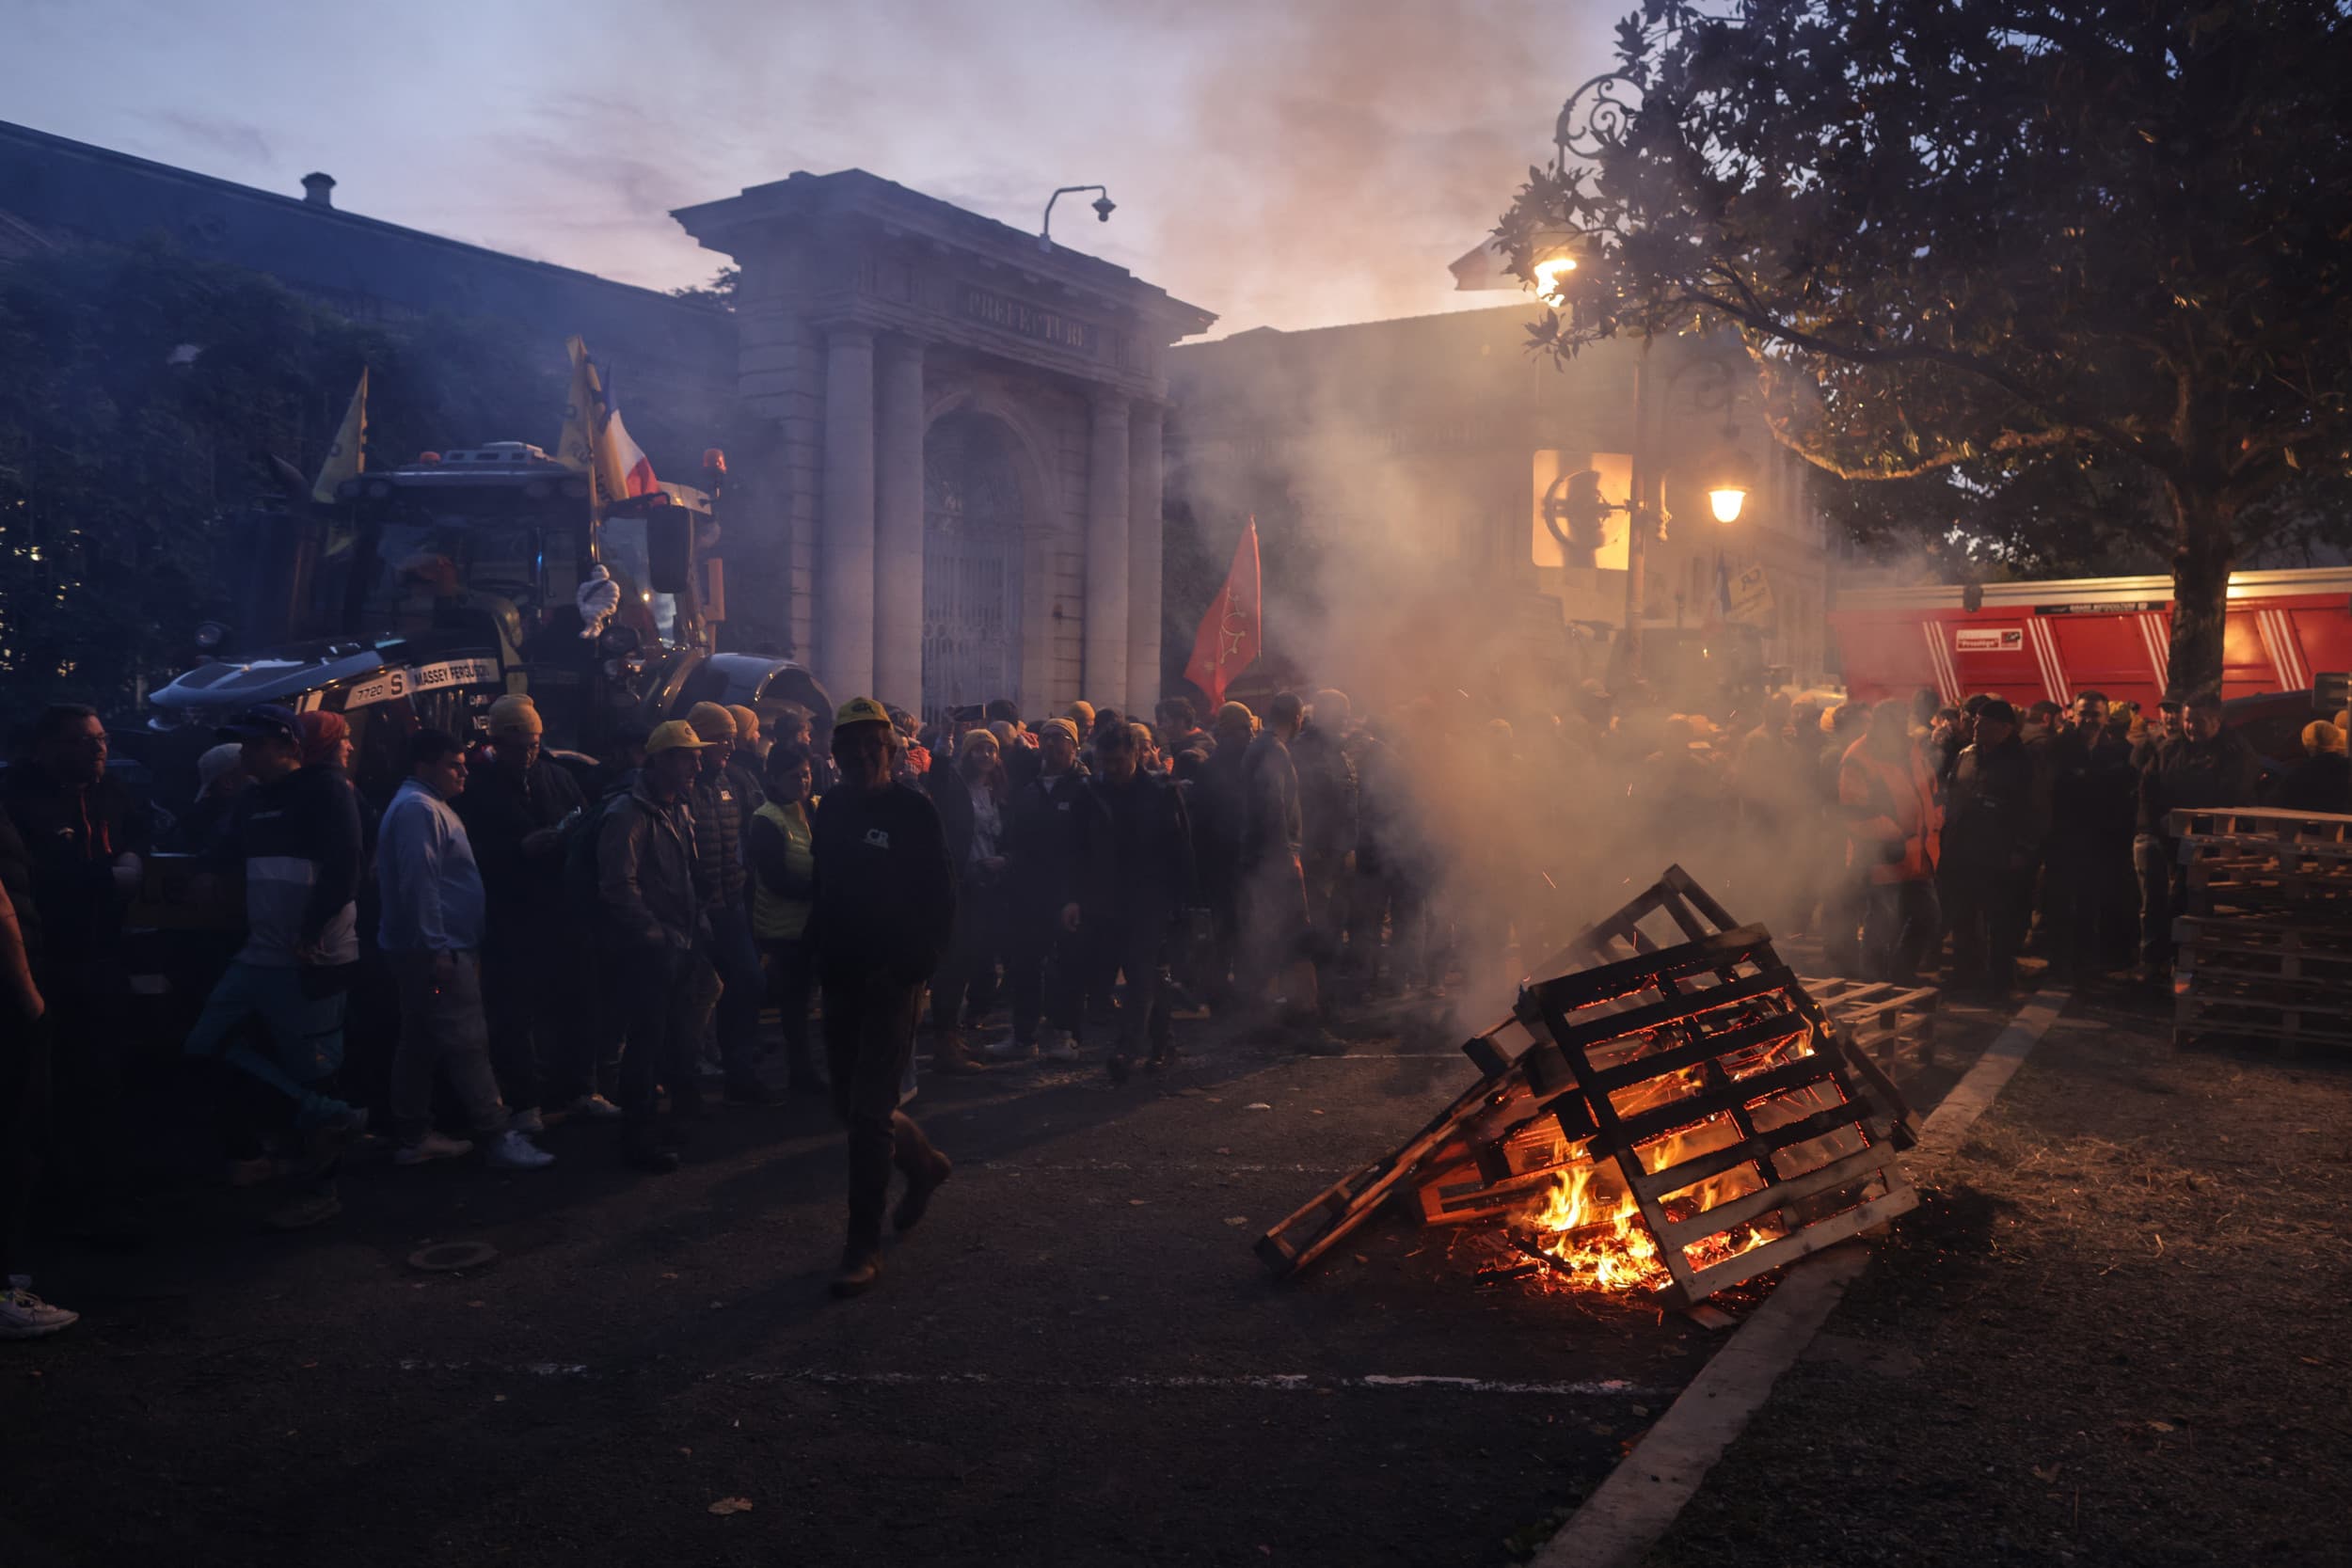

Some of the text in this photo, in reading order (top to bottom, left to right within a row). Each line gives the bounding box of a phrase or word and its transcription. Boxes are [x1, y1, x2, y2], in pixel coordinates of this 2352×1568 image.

[358, 673, 403, 700] 7720 S
[414, 669, 449, 685] MASSEY
